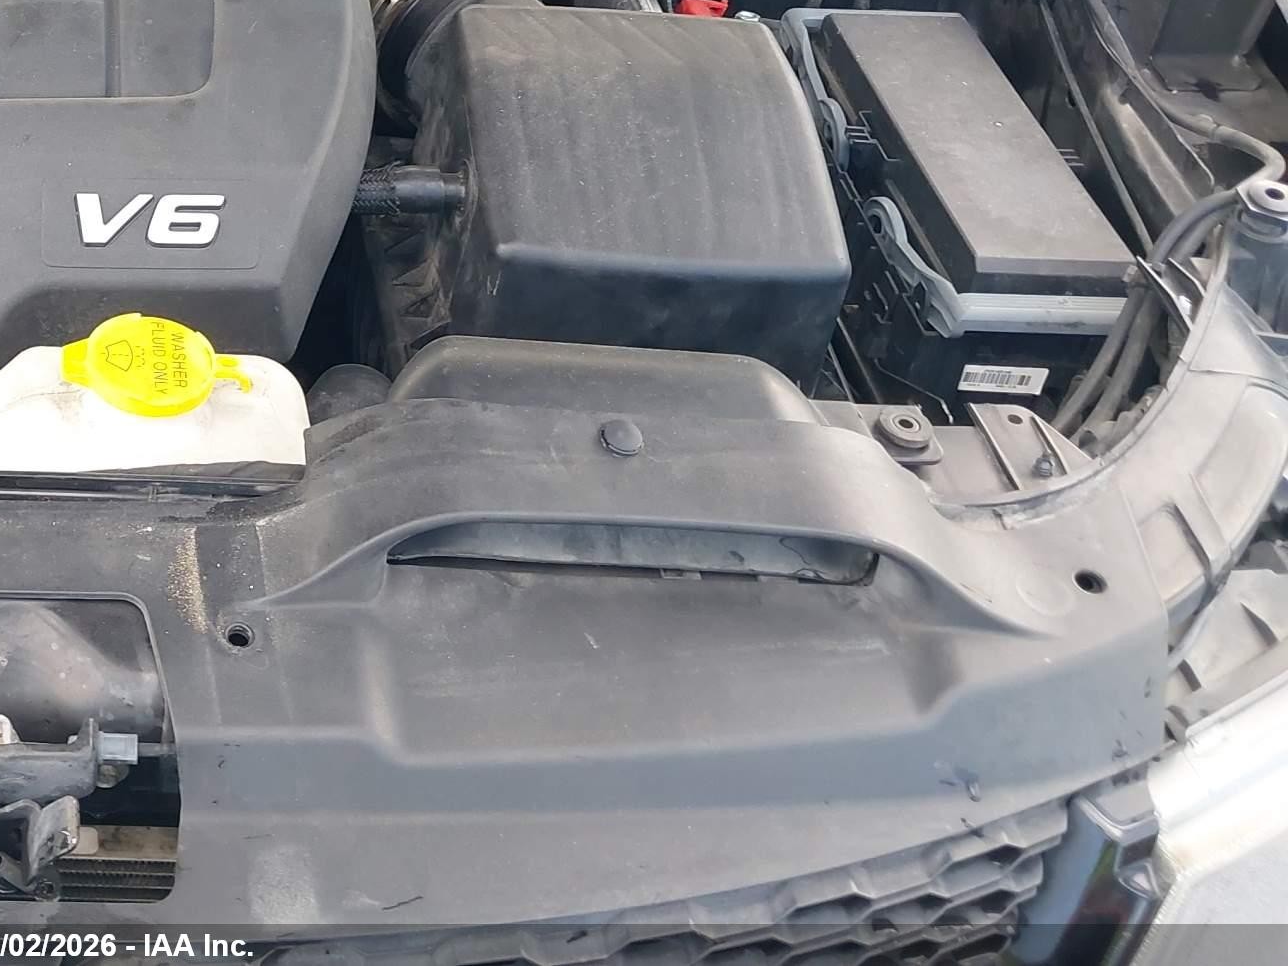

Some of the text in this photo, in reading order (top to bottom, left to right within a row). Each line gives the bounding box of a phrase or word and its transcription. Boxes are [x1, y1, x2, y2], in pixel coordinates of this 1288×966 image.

[74, 192, 227, 248] V6
[151, 321, 169, 395] FLUID ONLY
[171, 332, 188, 388] WASHER
